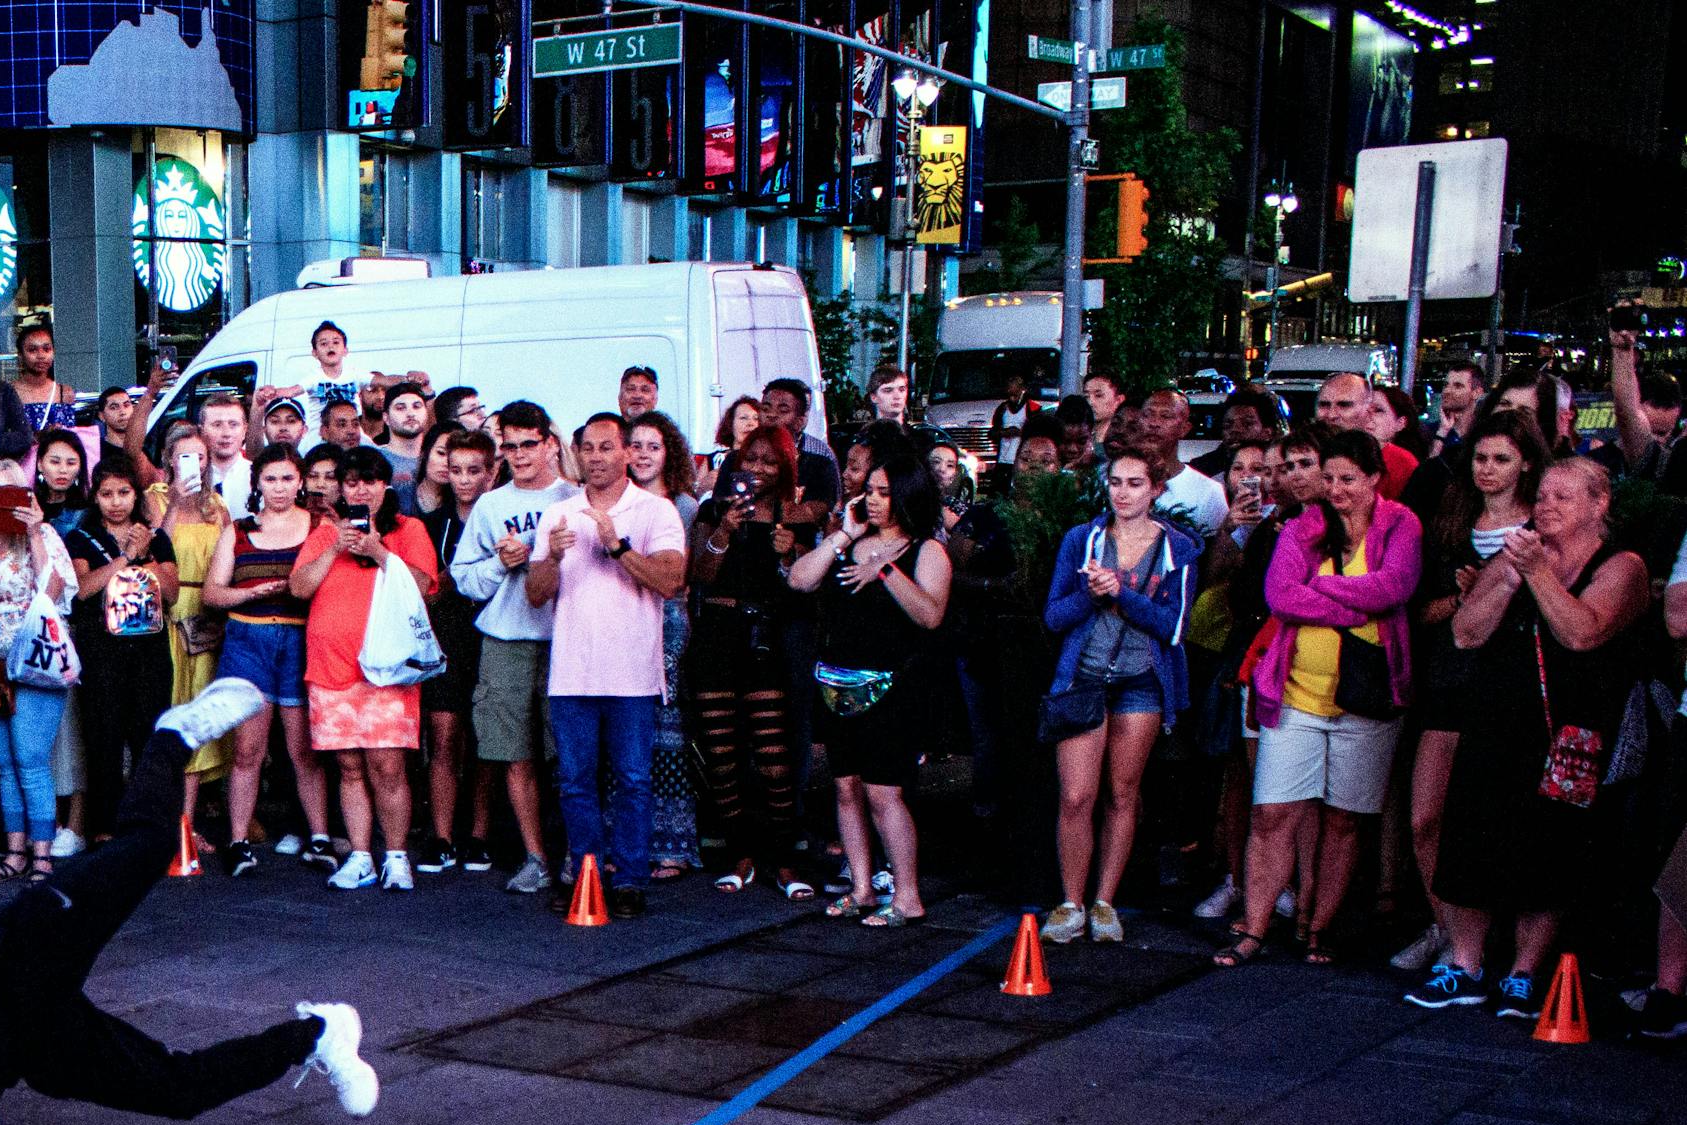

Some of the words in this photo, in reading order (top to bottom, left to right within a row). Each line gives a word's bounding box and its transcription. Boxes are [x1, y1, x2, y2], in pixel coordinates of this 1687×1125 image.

[567, 41, 585, 65] W
[594, 38, 617, 62] 47
[626, 34, 646, 58] St
[1038, 40, 1074, 62] Broadway
[1111, 52, 1123, 68] W
[1129, 49, 1147, 67] 47
[24, 638, 70, 673] NY
